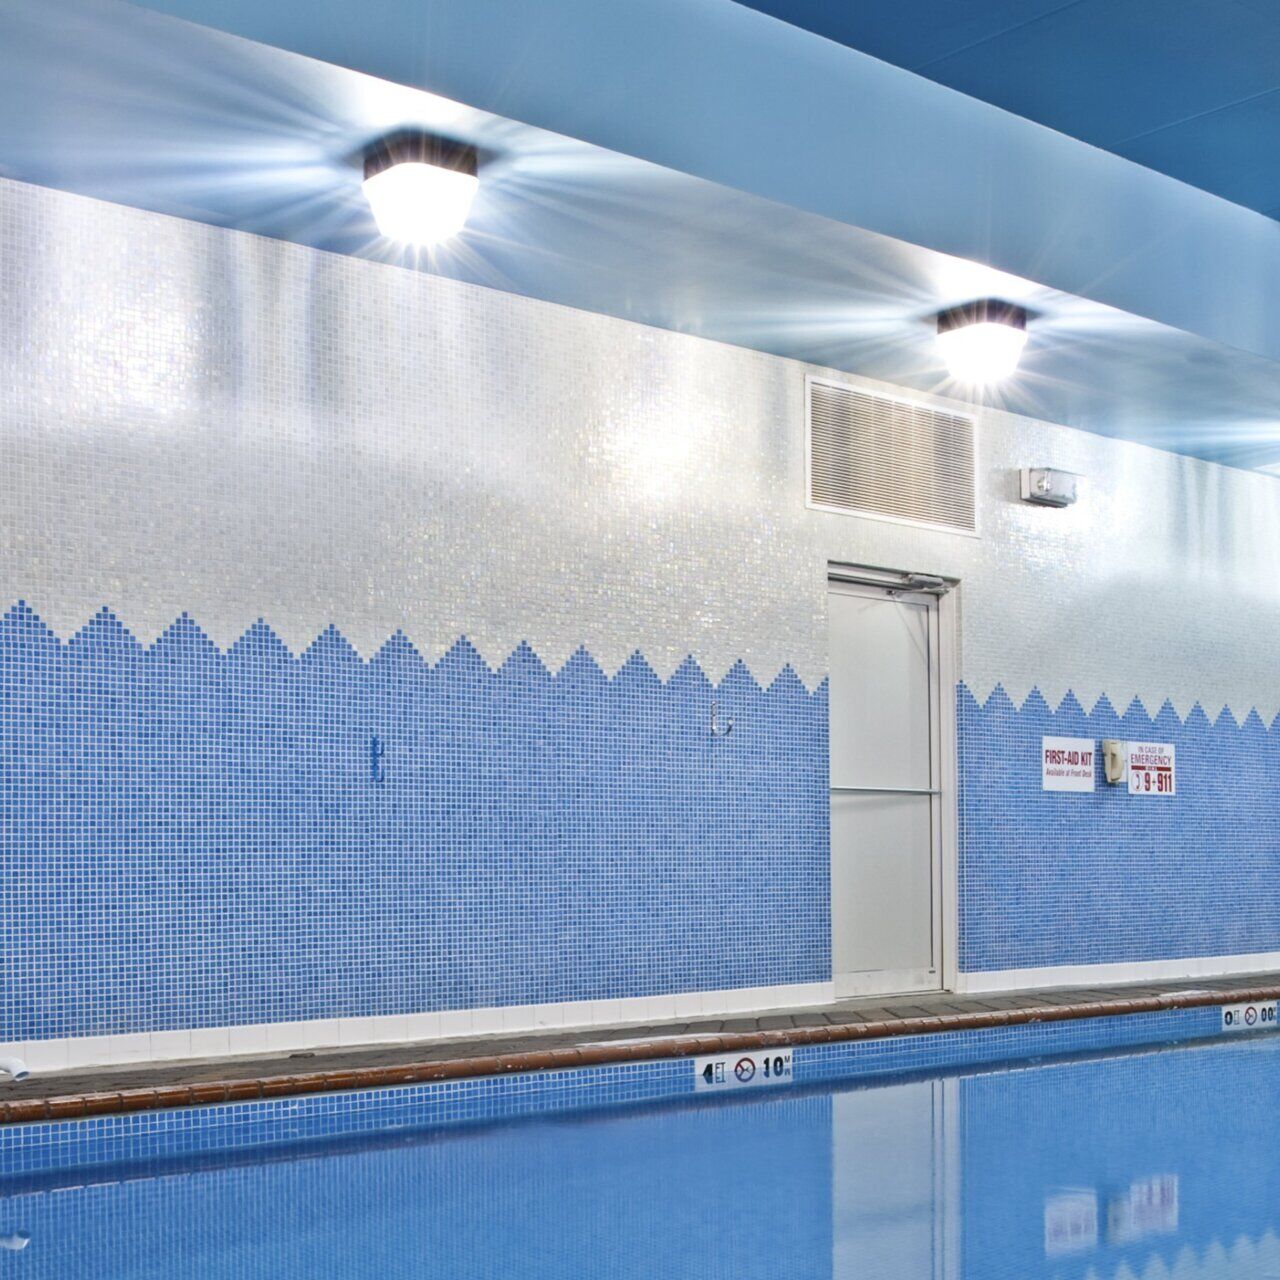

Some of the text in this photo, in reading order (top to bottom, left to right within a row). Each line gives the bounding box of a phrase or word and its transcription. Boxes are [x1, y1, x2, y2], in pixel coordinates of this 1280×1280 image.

[1044, 749, 1093, 766] FIRST-AID KIT
[1131, 753, 1172, 766] EMERGENCY
